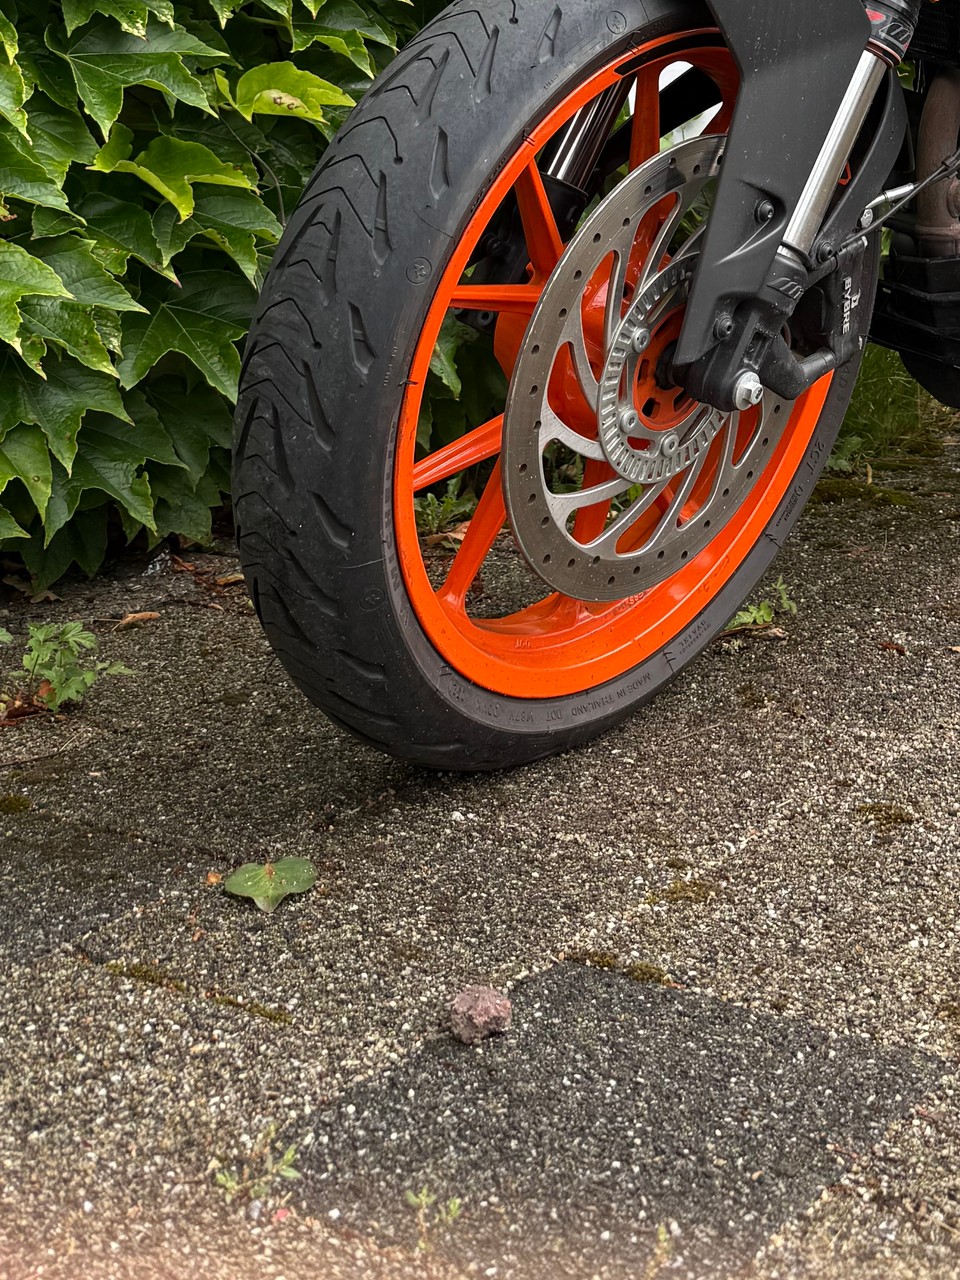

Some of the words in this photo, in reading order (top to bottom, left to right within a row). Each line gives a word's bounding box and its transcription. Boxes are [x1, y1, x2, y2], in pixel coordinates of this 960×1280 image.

[843, 276, 852, 335] BYBRE
[627, 672, 651, 693] MADE
[546, 709, 562, 722] DOT
[571, 694, 615, 716] THAILAND
